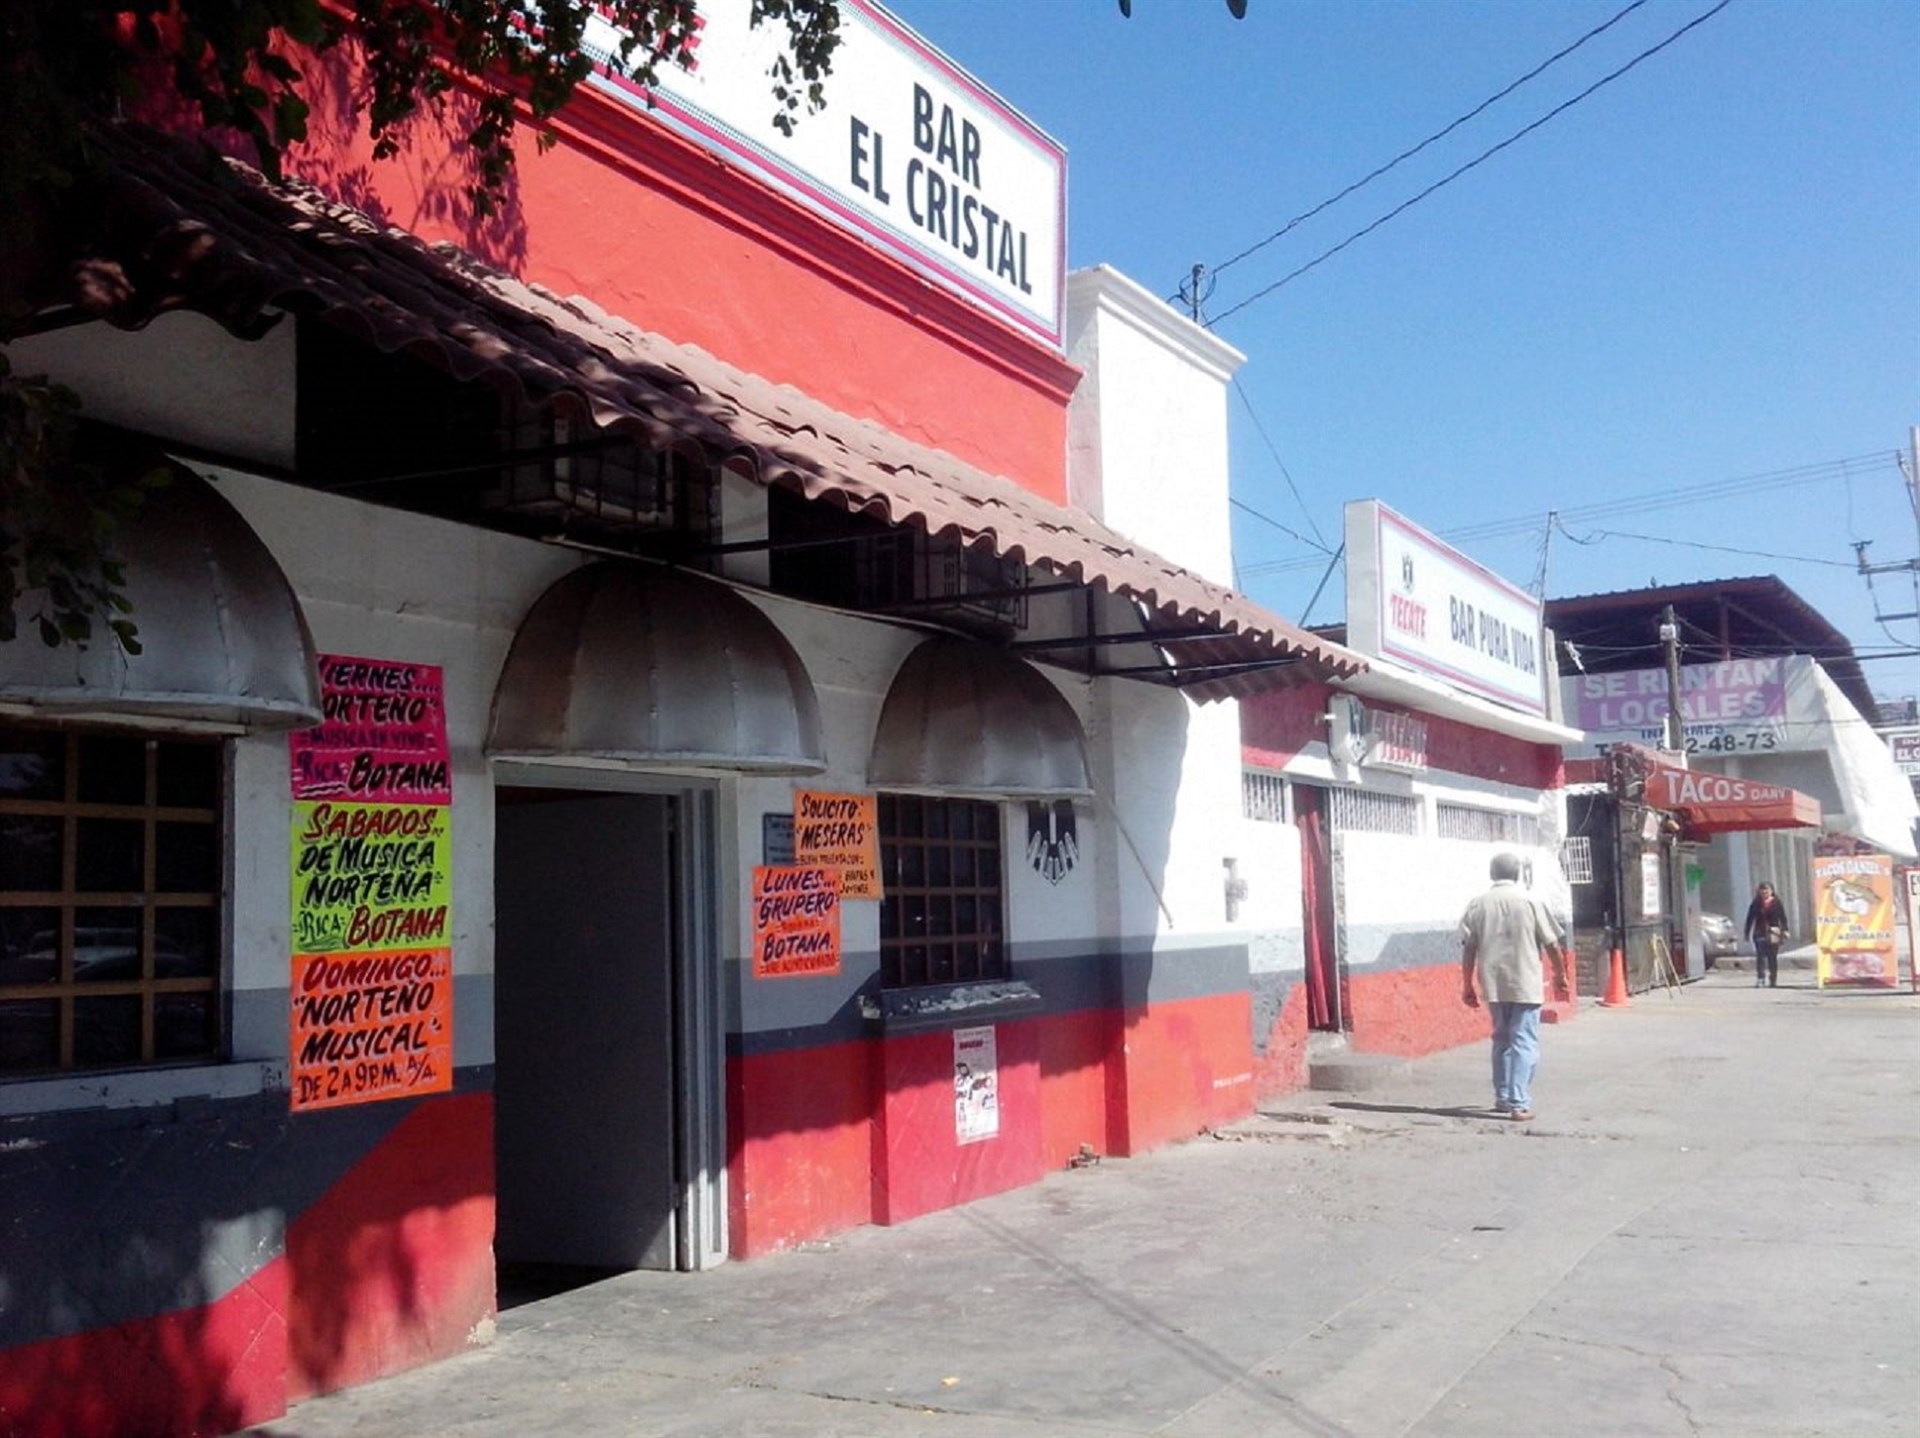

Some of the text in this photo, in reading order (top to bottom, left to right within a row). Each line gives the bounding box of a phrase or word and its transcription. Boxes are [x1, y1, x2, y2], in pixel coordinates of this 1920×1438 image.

[914, 82, 981, 190] BAR
[851, 115, 1032, 295] EL CRISTAL
[1391, 594, 1427, 639] TECATE
[1450, 594, 1536, 676] BAR PURA VIDA
[1584, 658, 1779, 699] SE RNTAN
[1663, 770, 1746, 805] TACOS
[300, 838, 436, 872] DE MUSICA
[305, 869, 434, 904] NORTEÑA
[299, 904, 448, 946] RICA BOTANA
[298, 1074, 322, 1104] DE
[327, 1065, 340, 1097] 2
[342, 1070, 352, 1091] A
